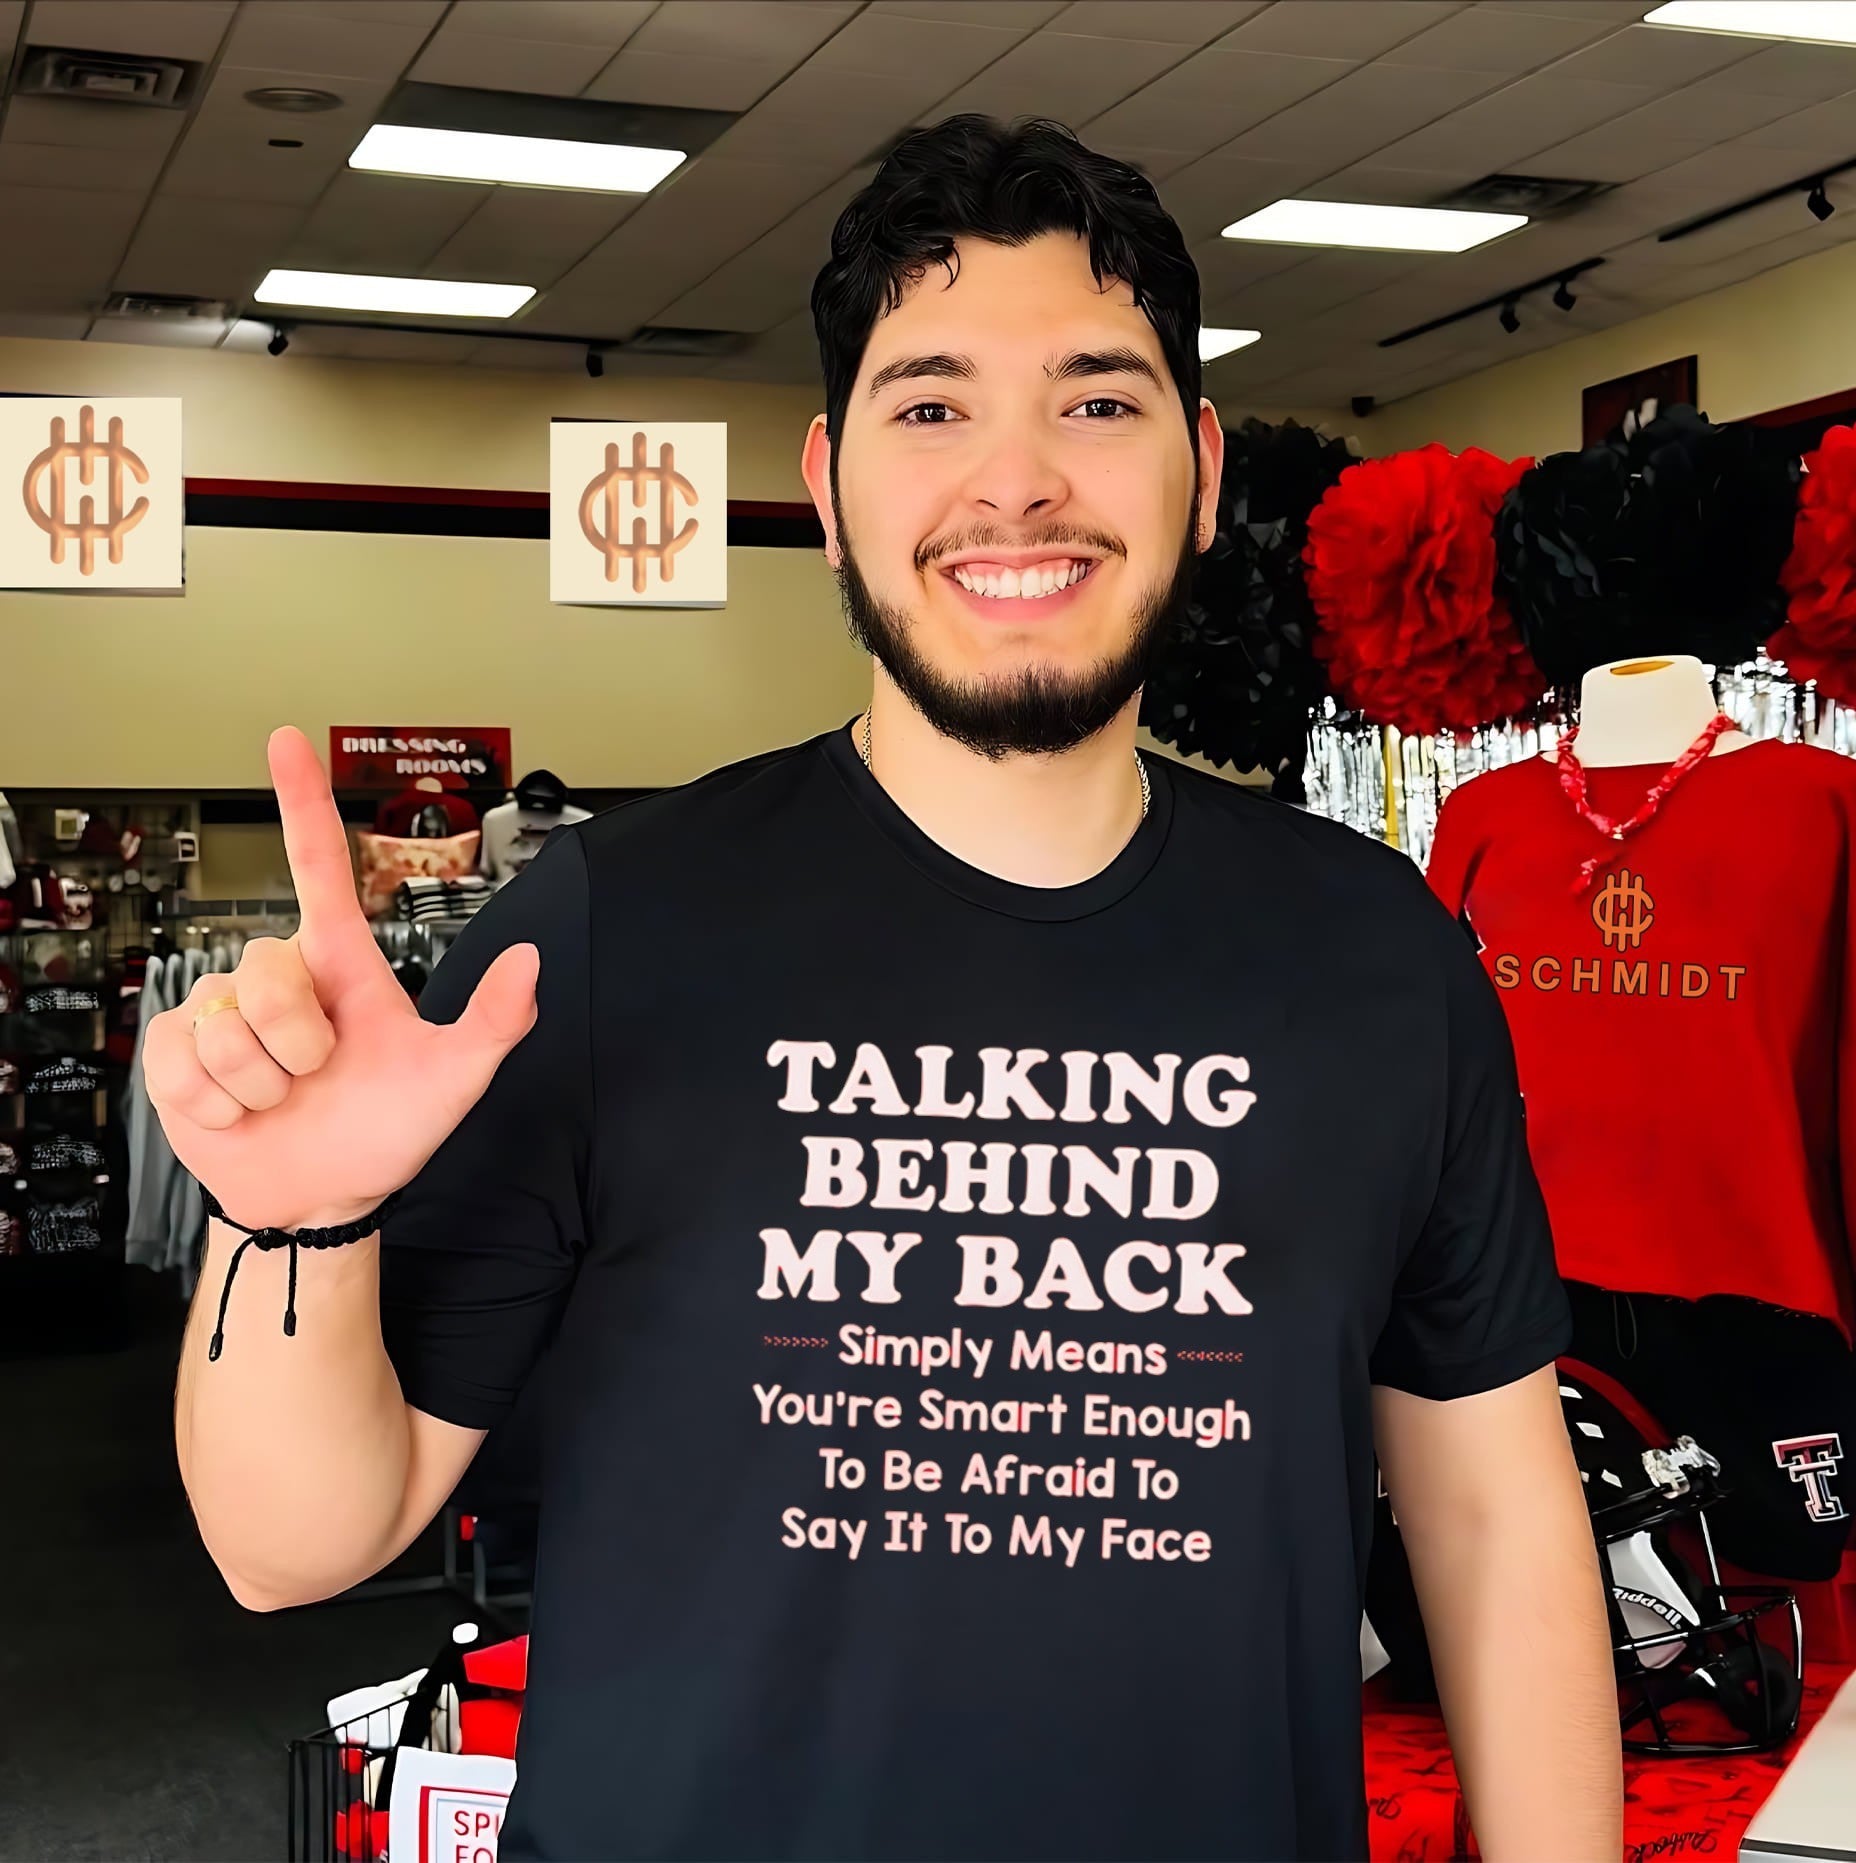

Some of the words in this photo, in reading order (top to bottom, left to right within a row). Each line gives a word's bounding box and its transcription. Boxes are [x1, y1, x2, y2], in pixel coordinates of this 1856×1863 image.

[341, 737, 467, 754] DRESSING
[395, 758, 487, 775] ROOMS
[1494, 954, 1746, 1000] SCHMIDT
[766, 1039, 1258, 1128] TALKING
[799, 1135, 1220, 1221] BEHIND
[756, 1227, 923, 1304] MY
[953, 1234, 1254, 1316] BACK
[838, 1323, 994, 1379] Simply
[1009, 1329, 1168, 1376] Means
[752, 1383, 903, 1429] You're
[918, 1388, 1068, 1435] Smart
[1083, 1393, 1251, 1449] Enough
[818, 1447, 866, 1490] To
[883, 1449, 943, 1493] Be
[960, 1452, 1116, 1499] Afraid
[1131, 1458, 1179, 1501] To
[781, 1506, 868, 1561] Say
[883, 1510, 928, 1553] It
[944, 1512, 993, 1555] To
[1008, 1514, 1086, 1568] My
[1101, 1517, 1212, 1563] Face
